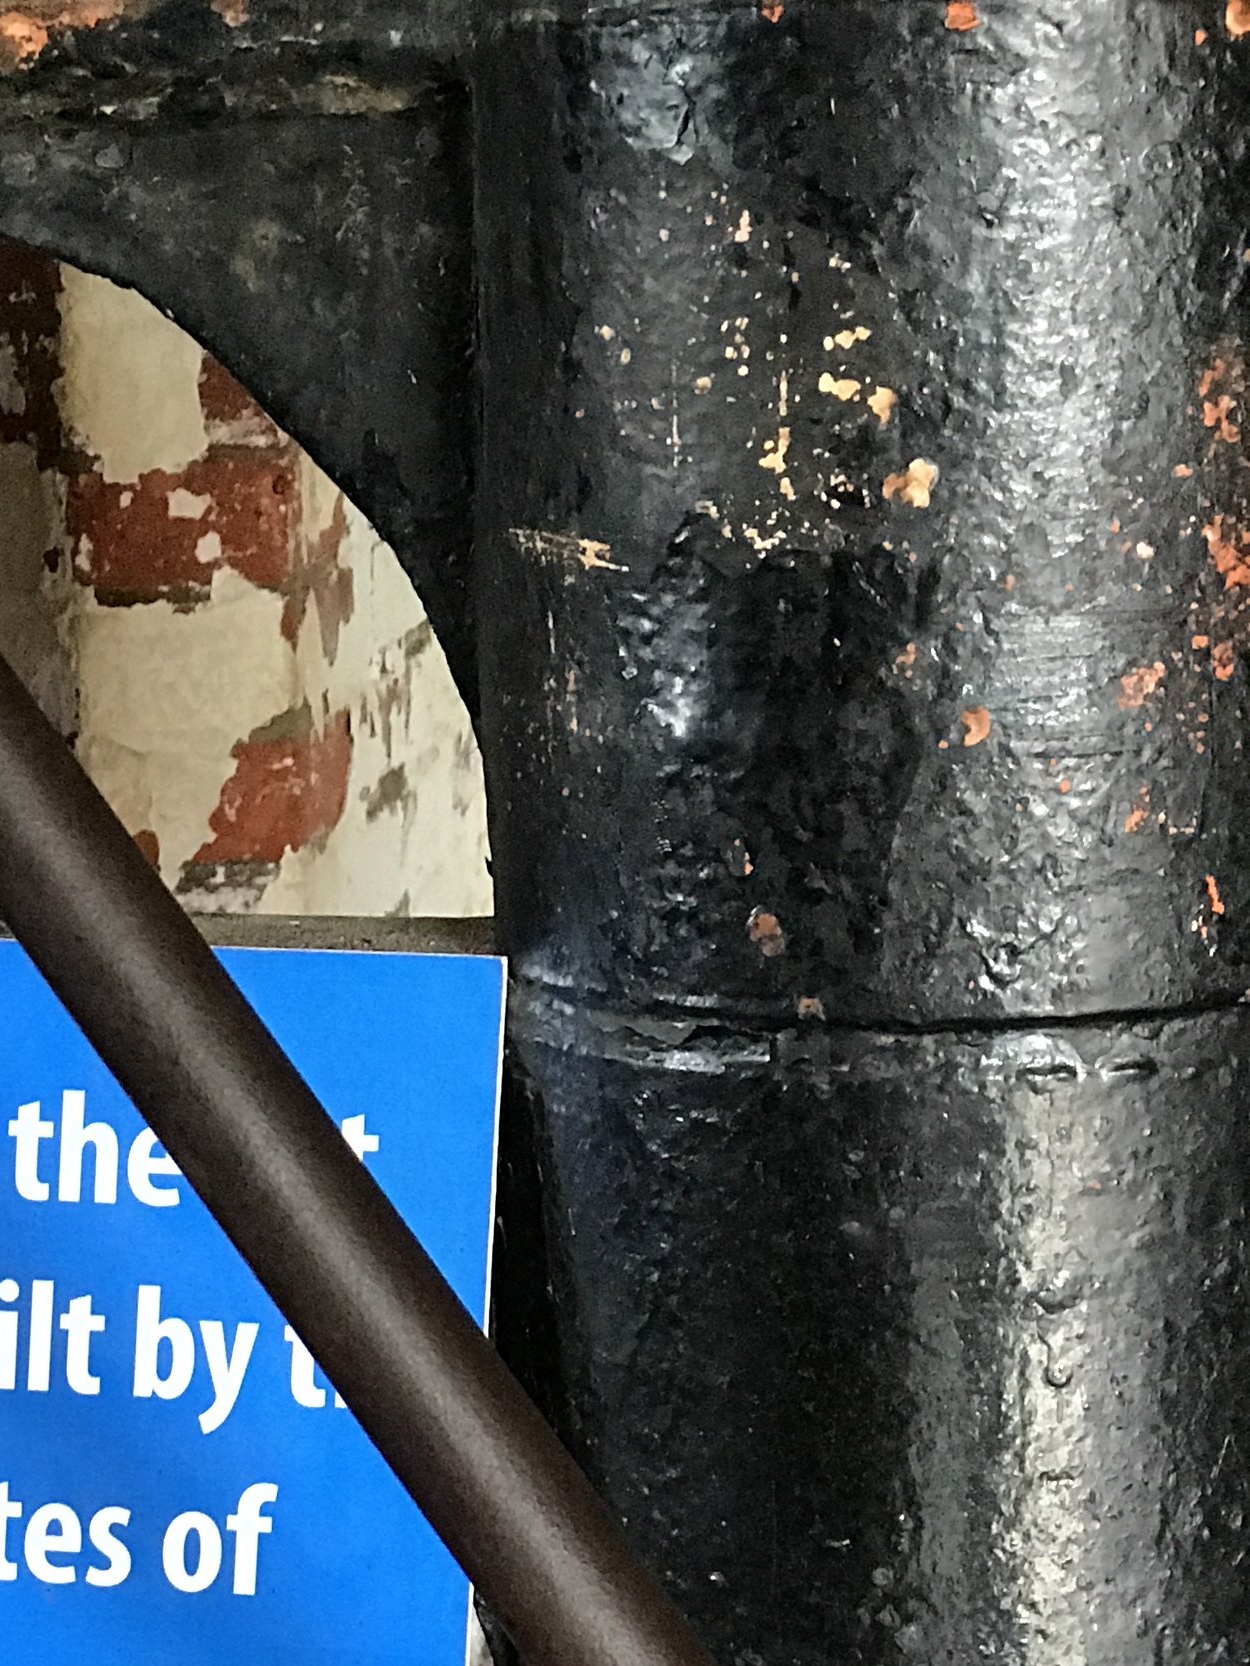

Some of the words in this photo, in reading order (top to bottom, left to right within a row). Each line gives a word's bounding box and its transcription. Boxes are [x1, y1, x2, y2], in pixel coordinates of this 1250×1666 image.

[7, 1089, 184, 1208] the
[132, 1284, 260, 1435] by
[162, 1482, 279, 1596] of
